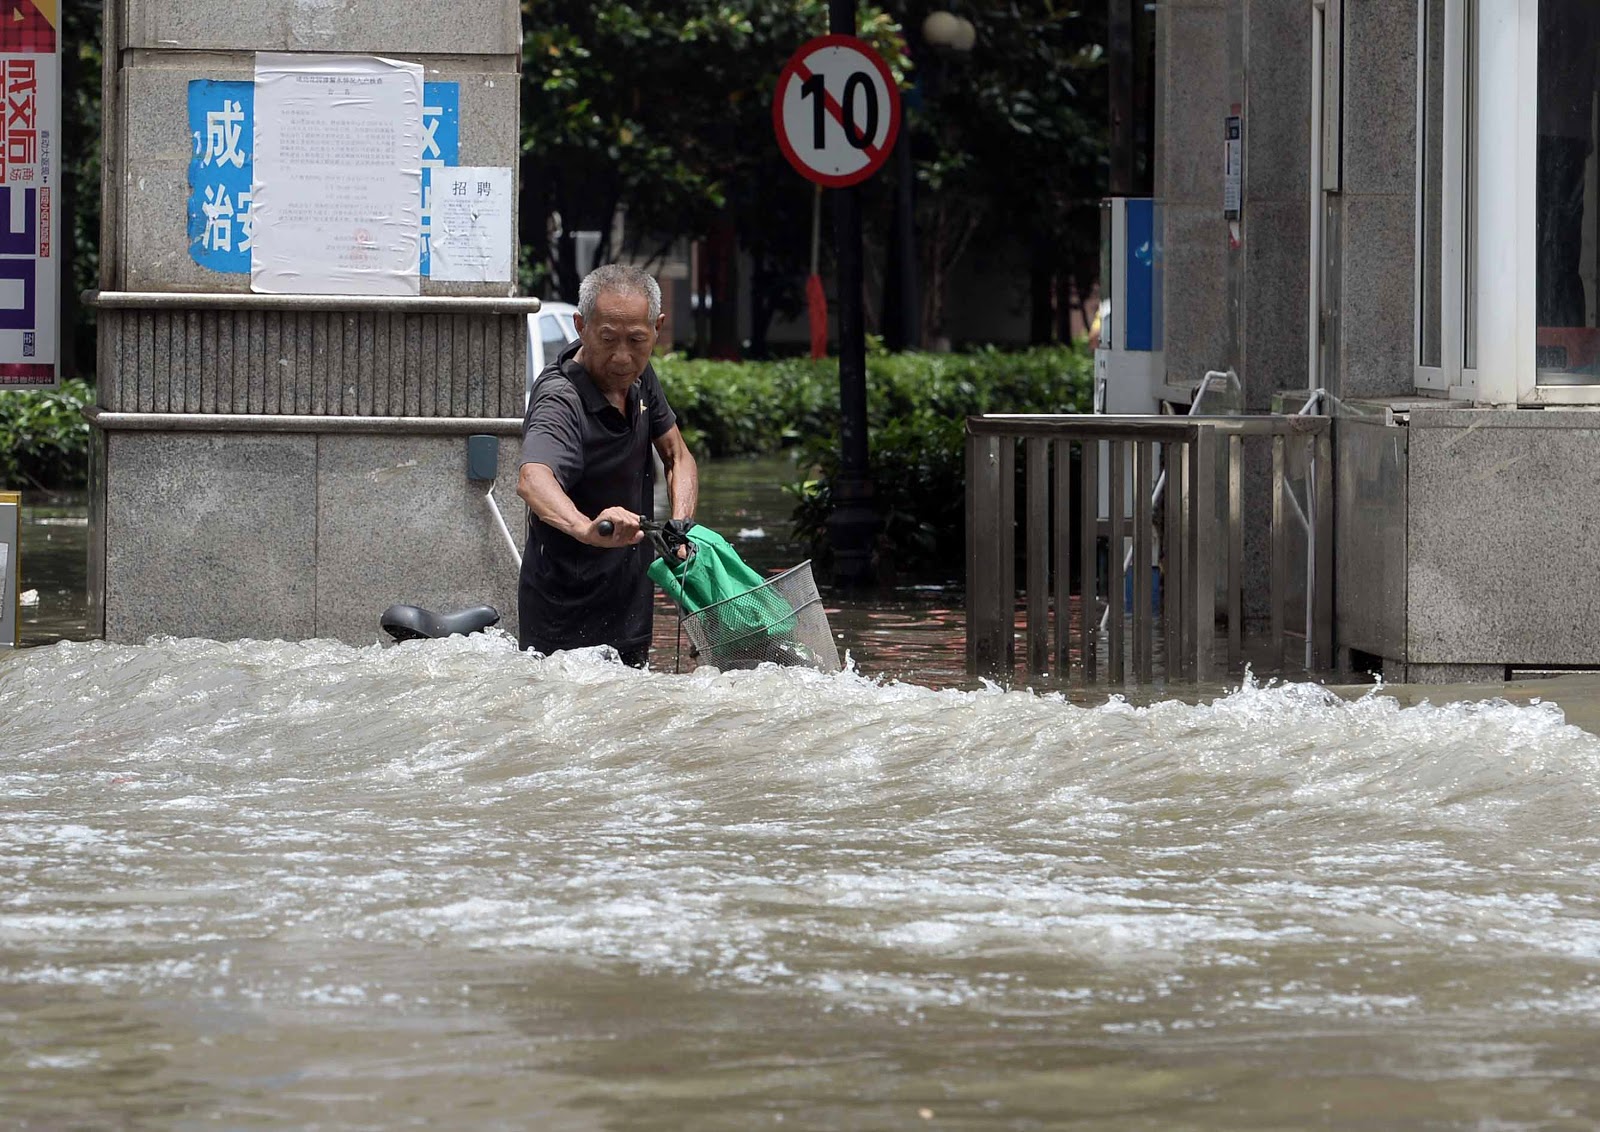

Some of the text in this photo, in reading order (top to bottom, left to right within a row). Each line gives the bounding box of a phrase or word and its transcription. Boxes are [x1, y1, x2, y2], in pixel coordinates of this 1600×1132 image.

[9, 60, 36, 163] 成交后
[203, 100, 245, 169] 成
[801, 72, 878, 150] 10
[452, 180, 492, 197] 招聘
